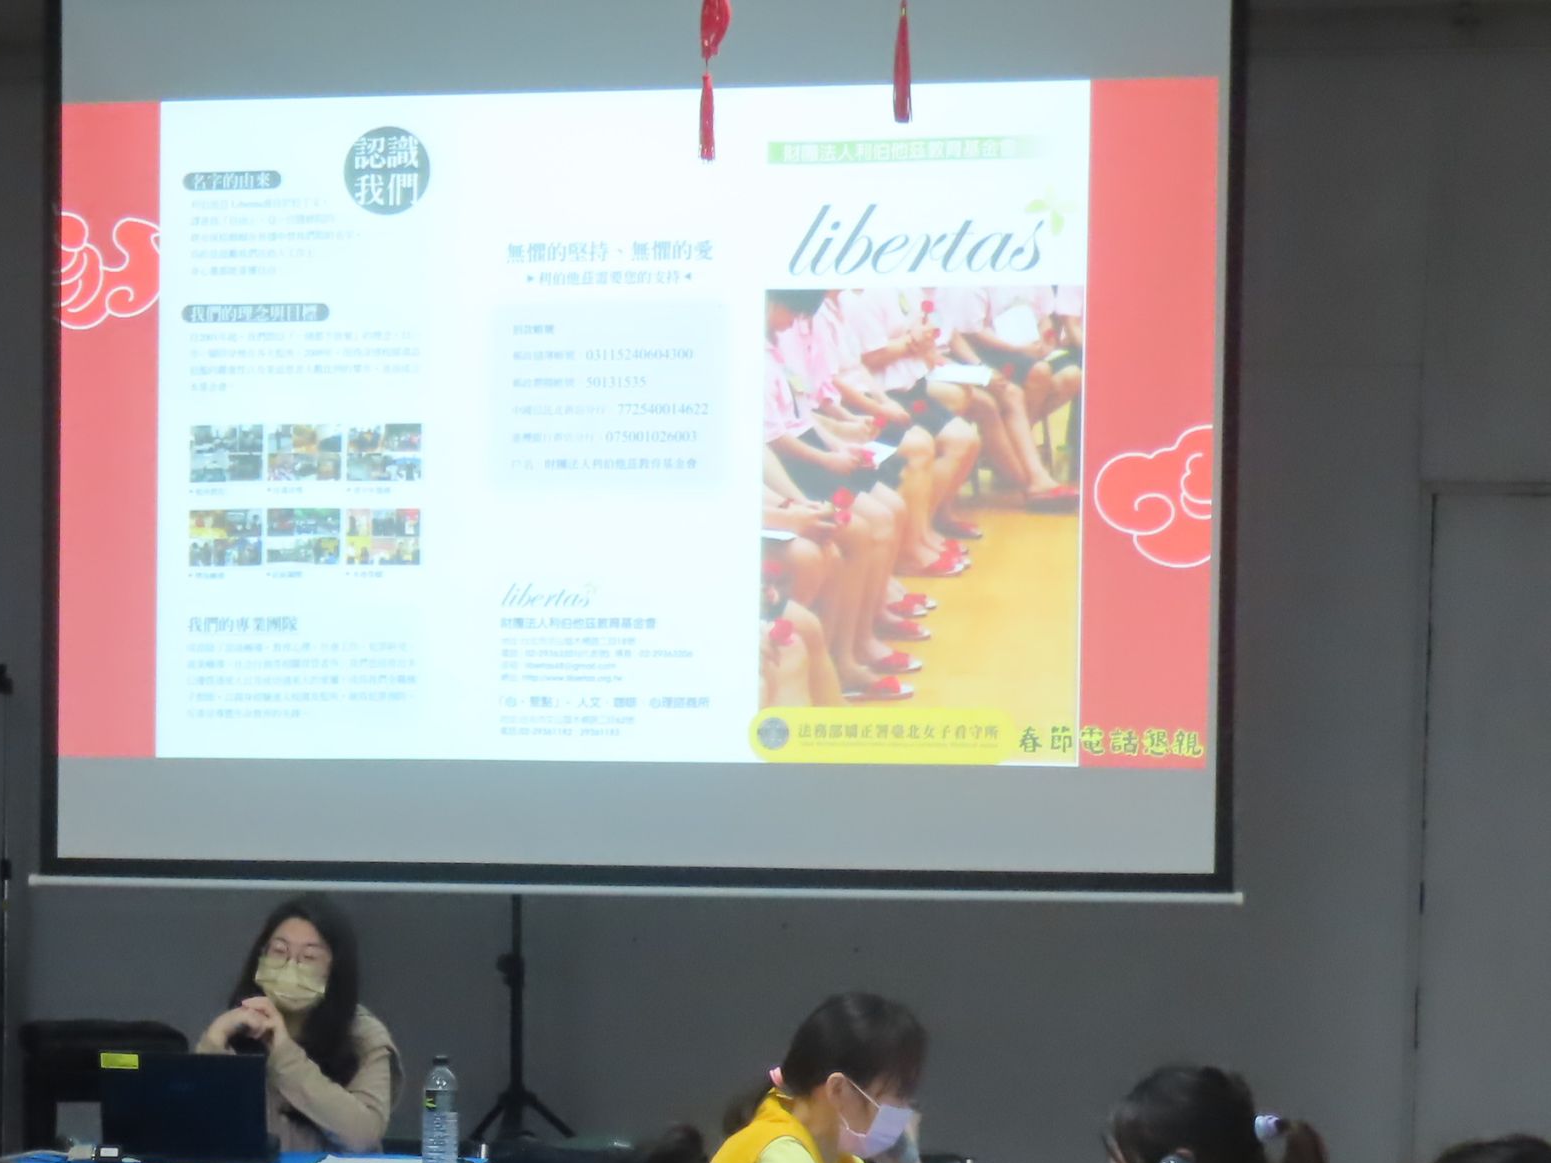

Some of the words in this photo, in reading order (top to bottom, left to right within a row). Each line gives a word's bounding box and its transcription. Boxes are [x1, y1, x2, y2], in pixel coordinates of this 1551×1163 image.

[354, 136, 420, 170] 認識
[193, 171, 271, 191] 名字的由來
[354, 173, 420, 207] 我們
[788, 203, 1045, 276] libertas
[586, 376, 647, 388] 50131535
[618, 402, 709, 416] 772540014622
[605, 429, 697, 443] 075001026003
[500, 581, 592, 608] libertas
[1018, 725, 1205, 757] 春節電話懇親
